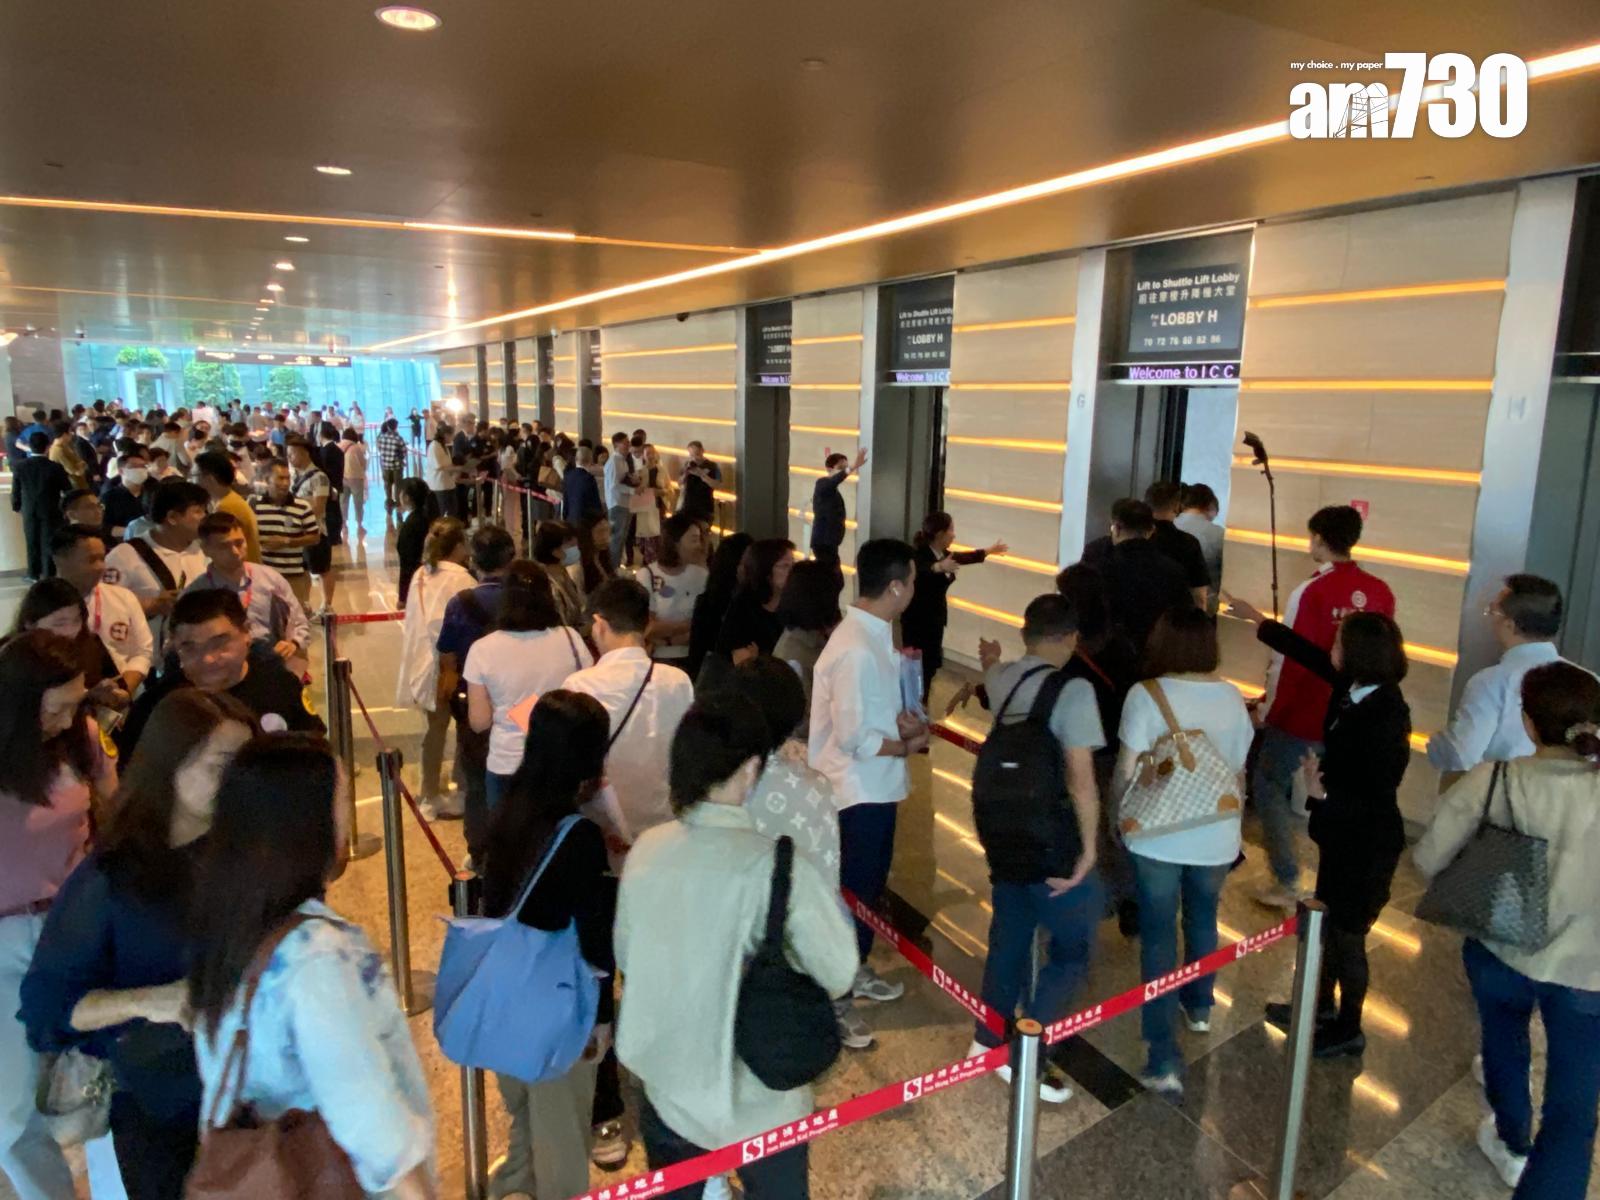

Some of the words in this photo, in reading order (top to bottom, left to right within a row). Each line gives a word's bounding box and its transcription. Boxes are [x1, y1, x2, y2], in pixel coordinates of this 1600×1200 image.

[1137, 281, 1151, 291] Lift
[1152, 280, 1160, 289] to
[1162, 277, 1193, 289] Shuttle
[1194, 274, 1210, 285] Lift
[1212, 271, 1241, 284] Lobby
[1160, 311, 1204, 326] LOBBY
[1207, 309, 1218, 323] H
[912, 334, 936, 345] LOBBY
[937, 333, 943, 343] H
[1157, 337, 1166, 346] 72
[896, 373, 924, 382] Welcome
[1129, 367, 1181, 379] Welcome
[1185, 366, 1197, 378] to
